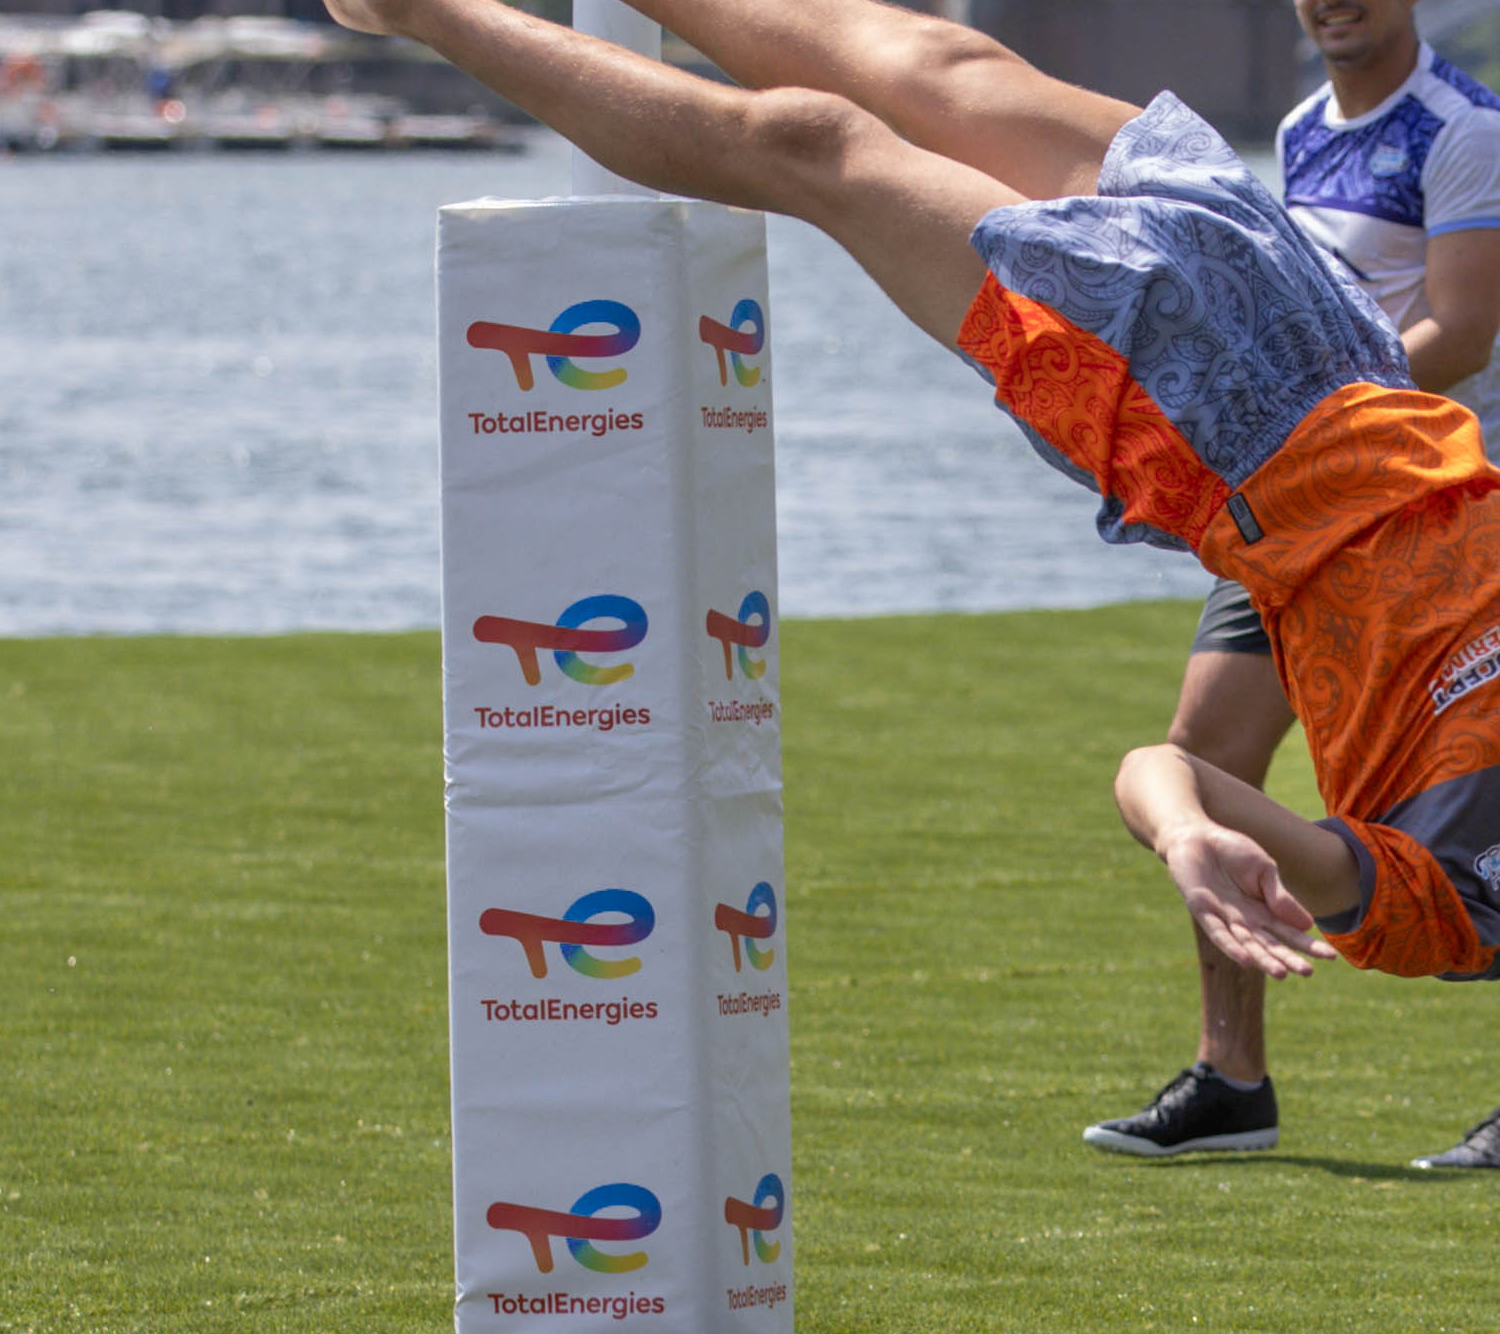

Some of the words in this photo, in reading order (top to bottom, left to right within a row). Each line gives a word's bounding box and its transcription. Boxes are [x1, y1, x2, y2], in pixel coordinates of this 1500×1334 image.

[468, 409, 644, 437] TotalEnergies
[700, 407, 768, 434] TotalEnergies
[474, 703, 651, 733] TotalEnergies
[707, 699, 774, 728] TotalEnergies
[480, 997, 659, 1026] TotalEnergies
[716, 990, 782, 1018] TotalEnergies
[487, 1292, 666, 1320] TotalEnergies
[726, 1281, 788, 1310] TotalEnergies
